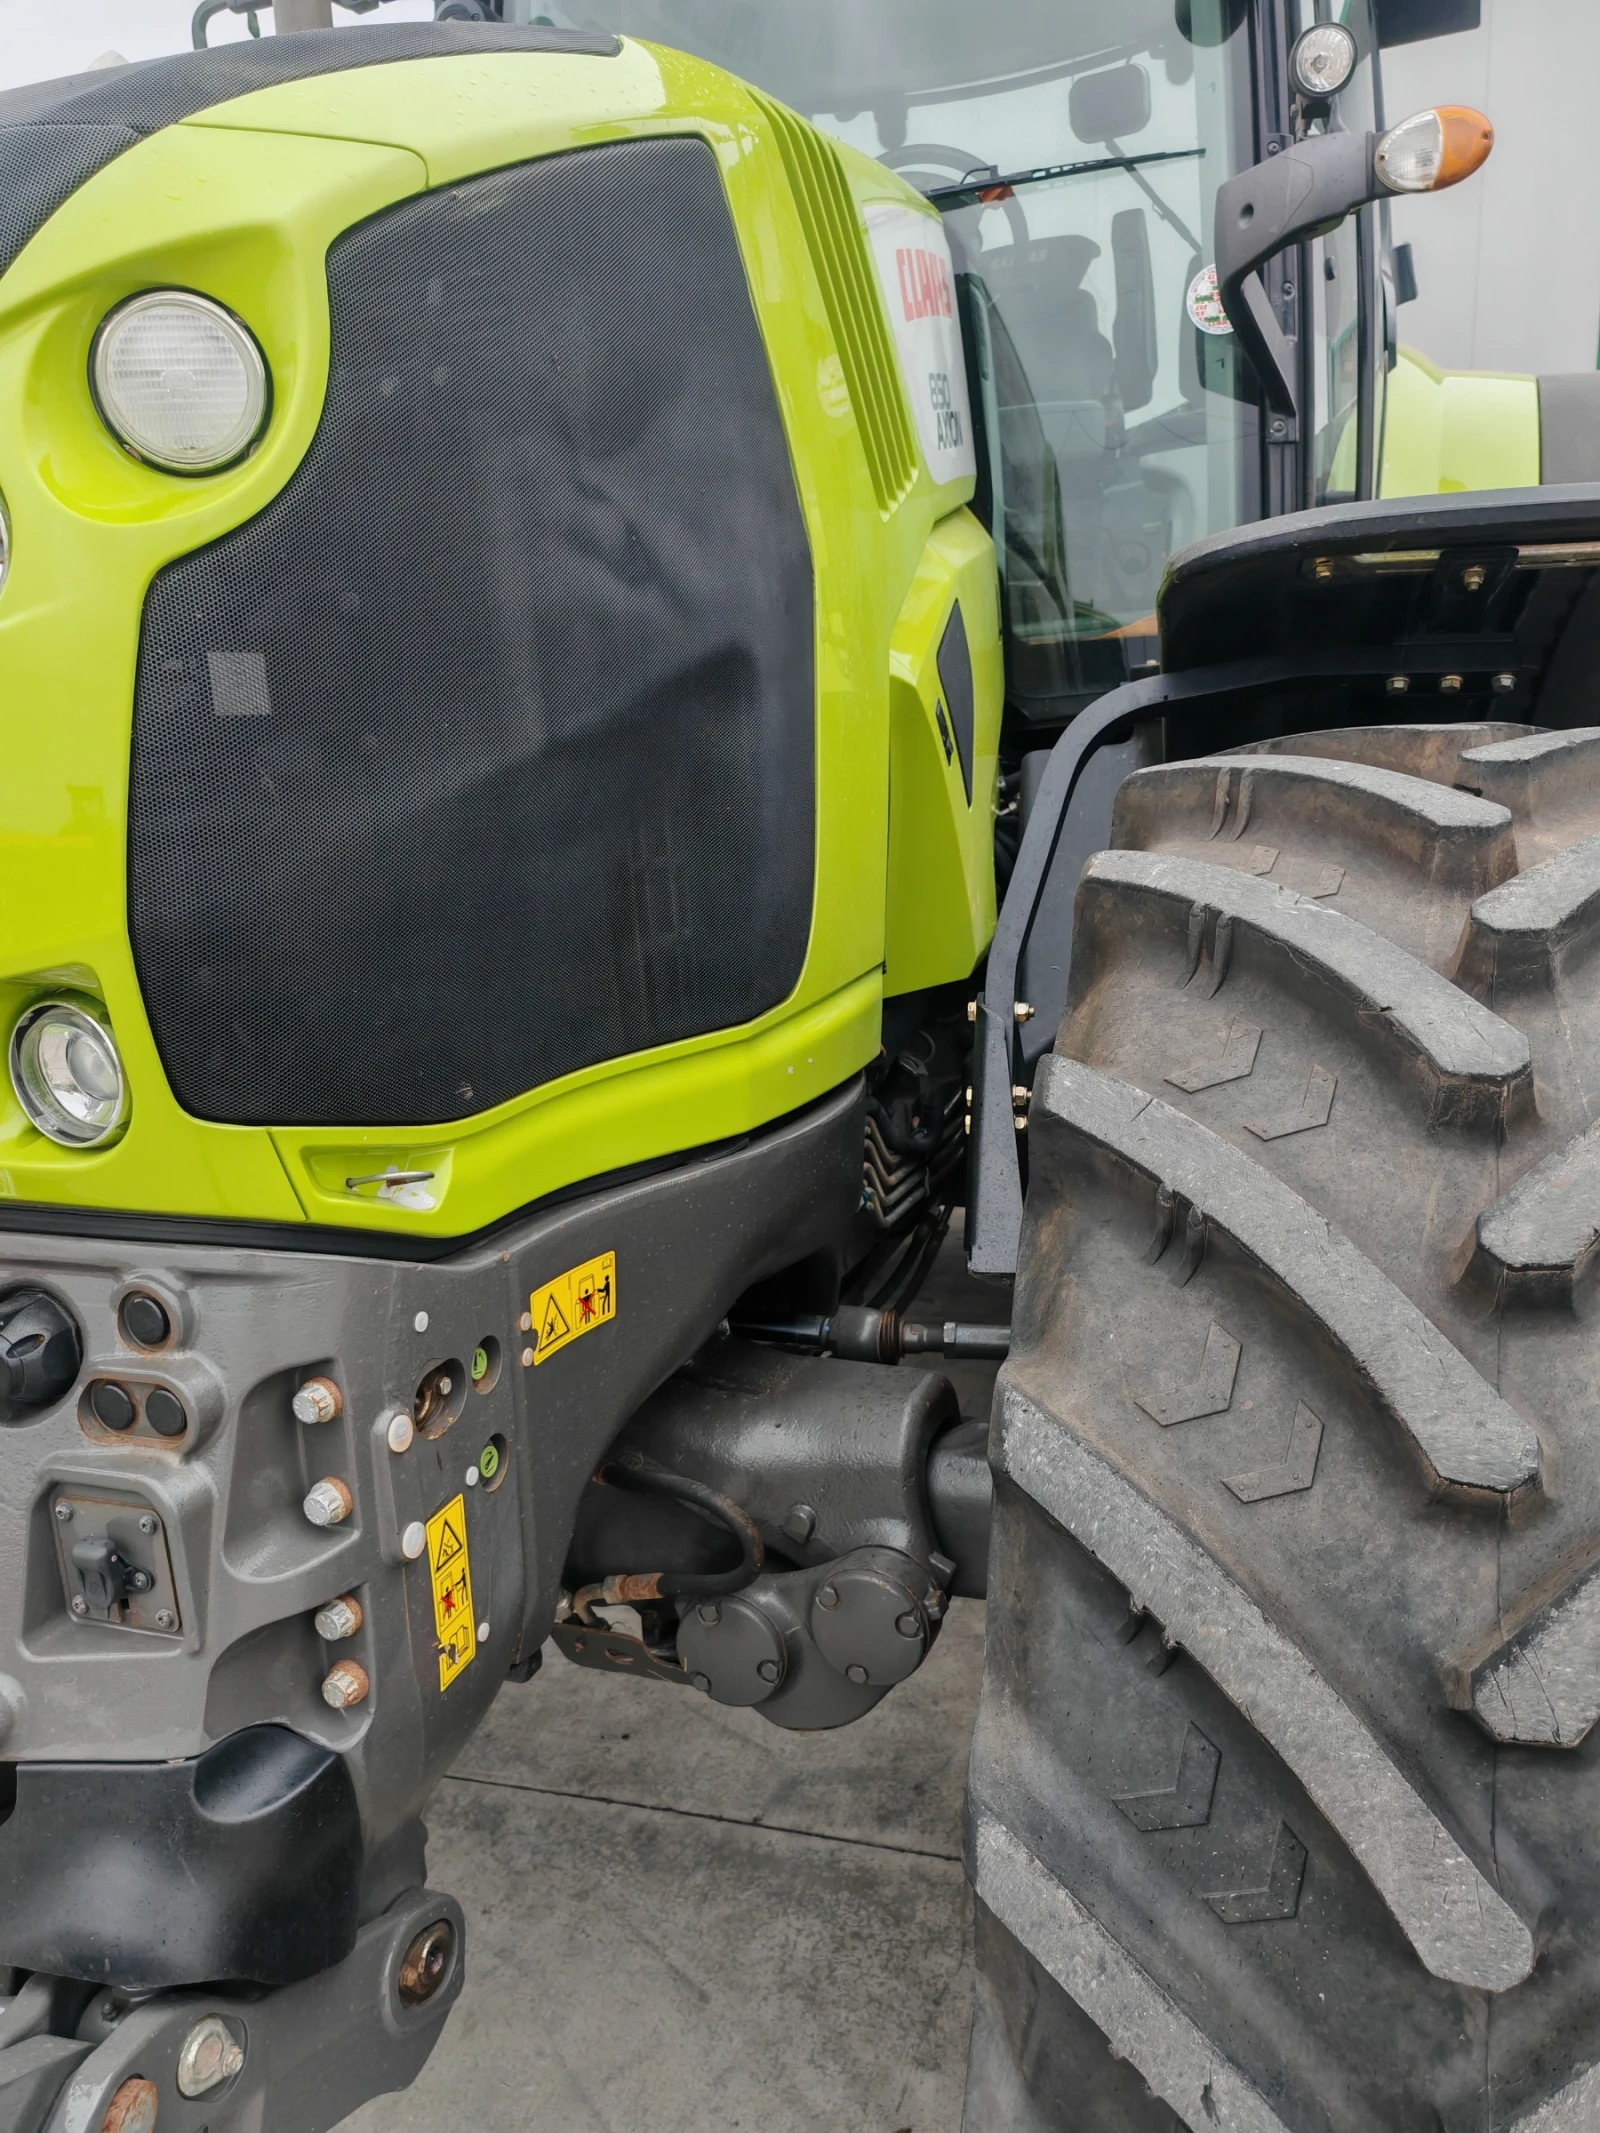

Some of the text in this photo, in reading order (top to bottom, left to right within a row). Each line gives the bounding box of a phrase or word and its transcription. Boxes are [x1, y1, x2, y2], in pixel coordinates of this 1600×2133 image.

[896, 248, 952, 322] CLAAS
[928, 373, 951, 411] 850
[936, 411, 963, 450] AXION
